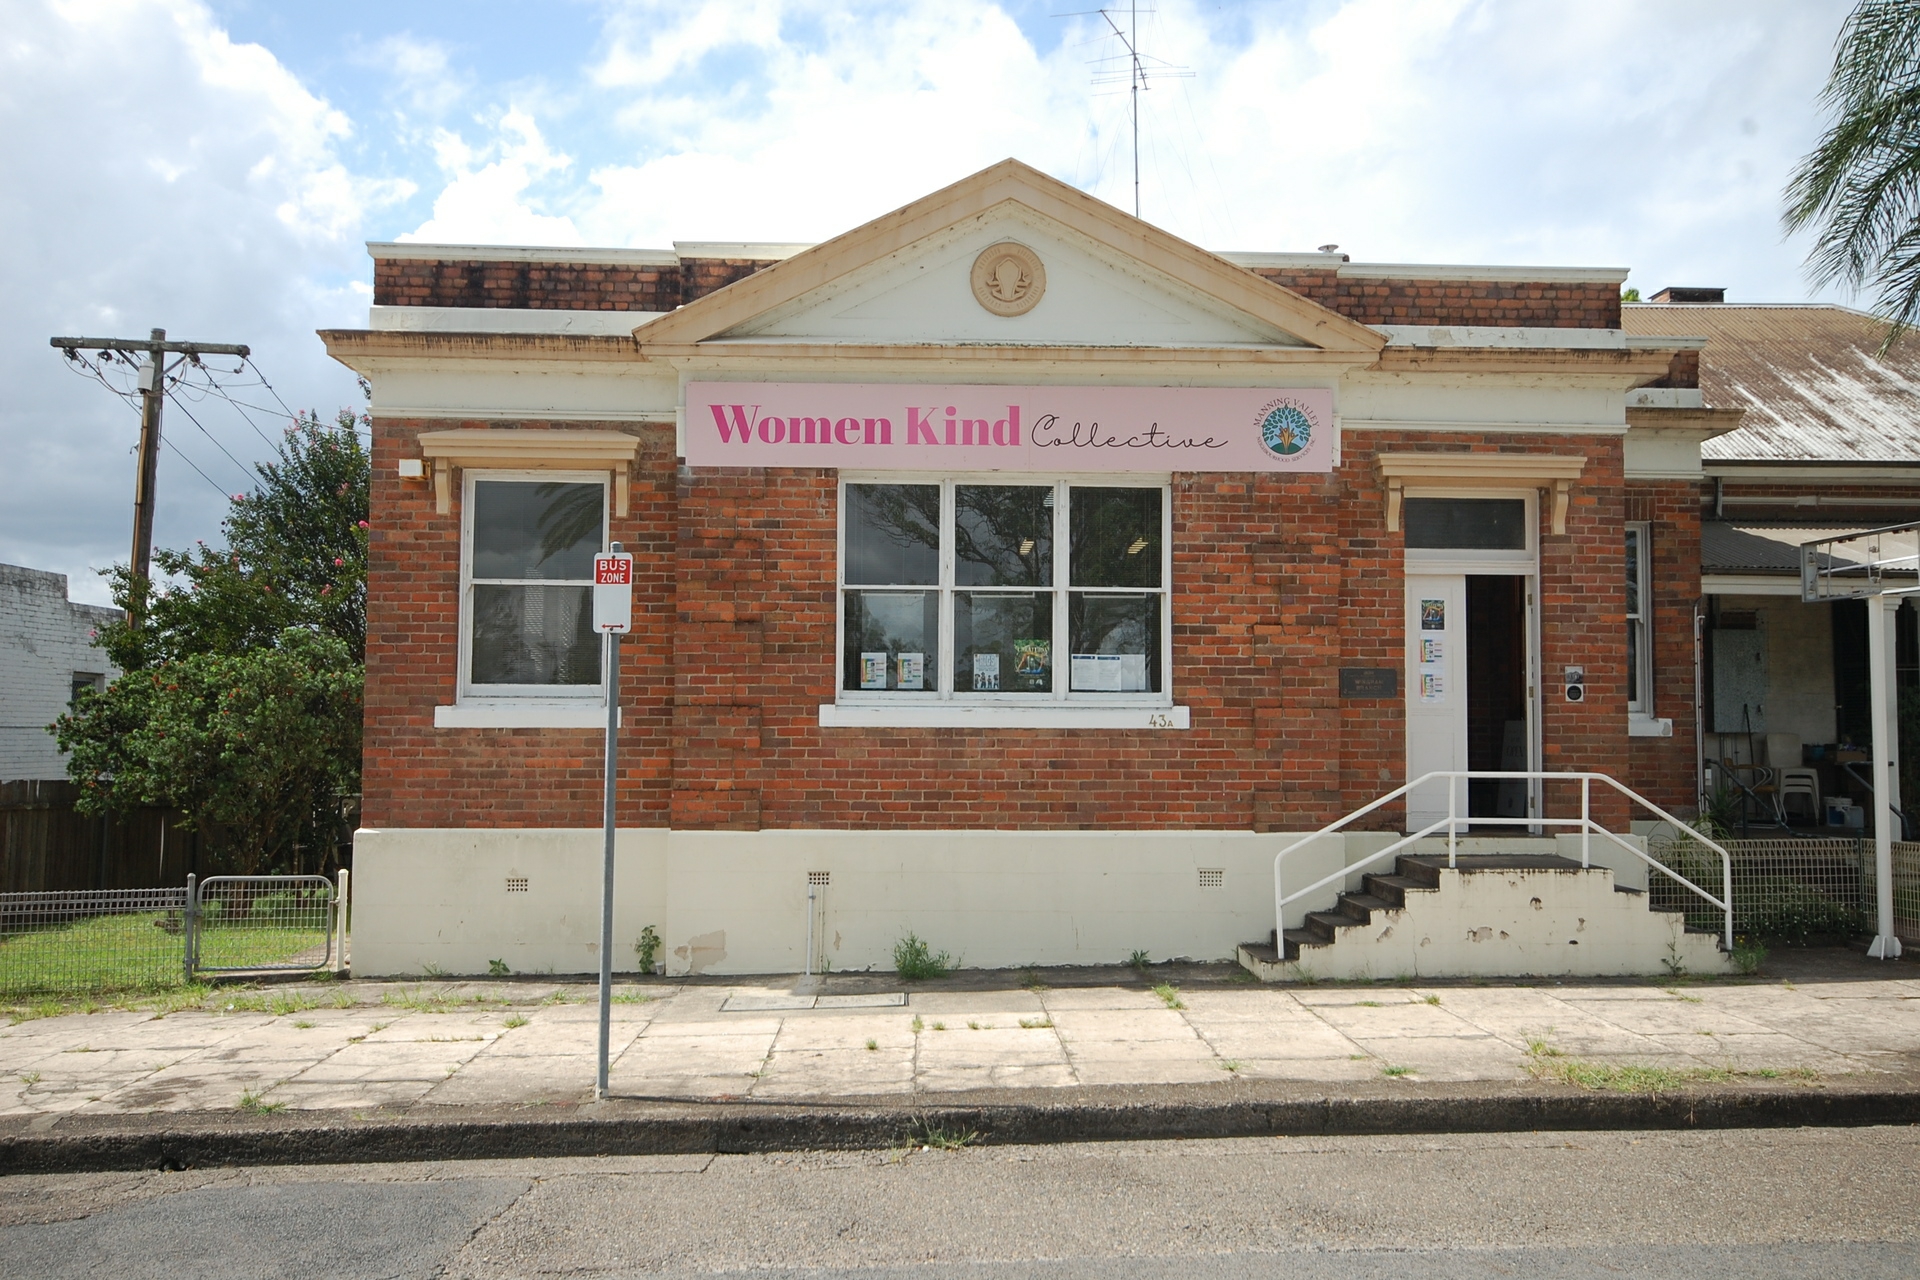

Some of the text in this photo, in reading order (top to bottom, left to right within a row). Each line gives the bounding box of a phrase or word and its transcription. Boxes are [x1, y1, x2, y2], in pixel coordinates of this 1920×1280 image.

[1253, 397, 1320, 427] MANNING VALLEY
[707, 404, 1022, 447] Women Kind
[1031, 413, 1229, 448] Collective
[599, 560, 627, 571] BUS
[600, 572, 625, 583] ZONE
[1148, 714, 1174, 728] 43A
